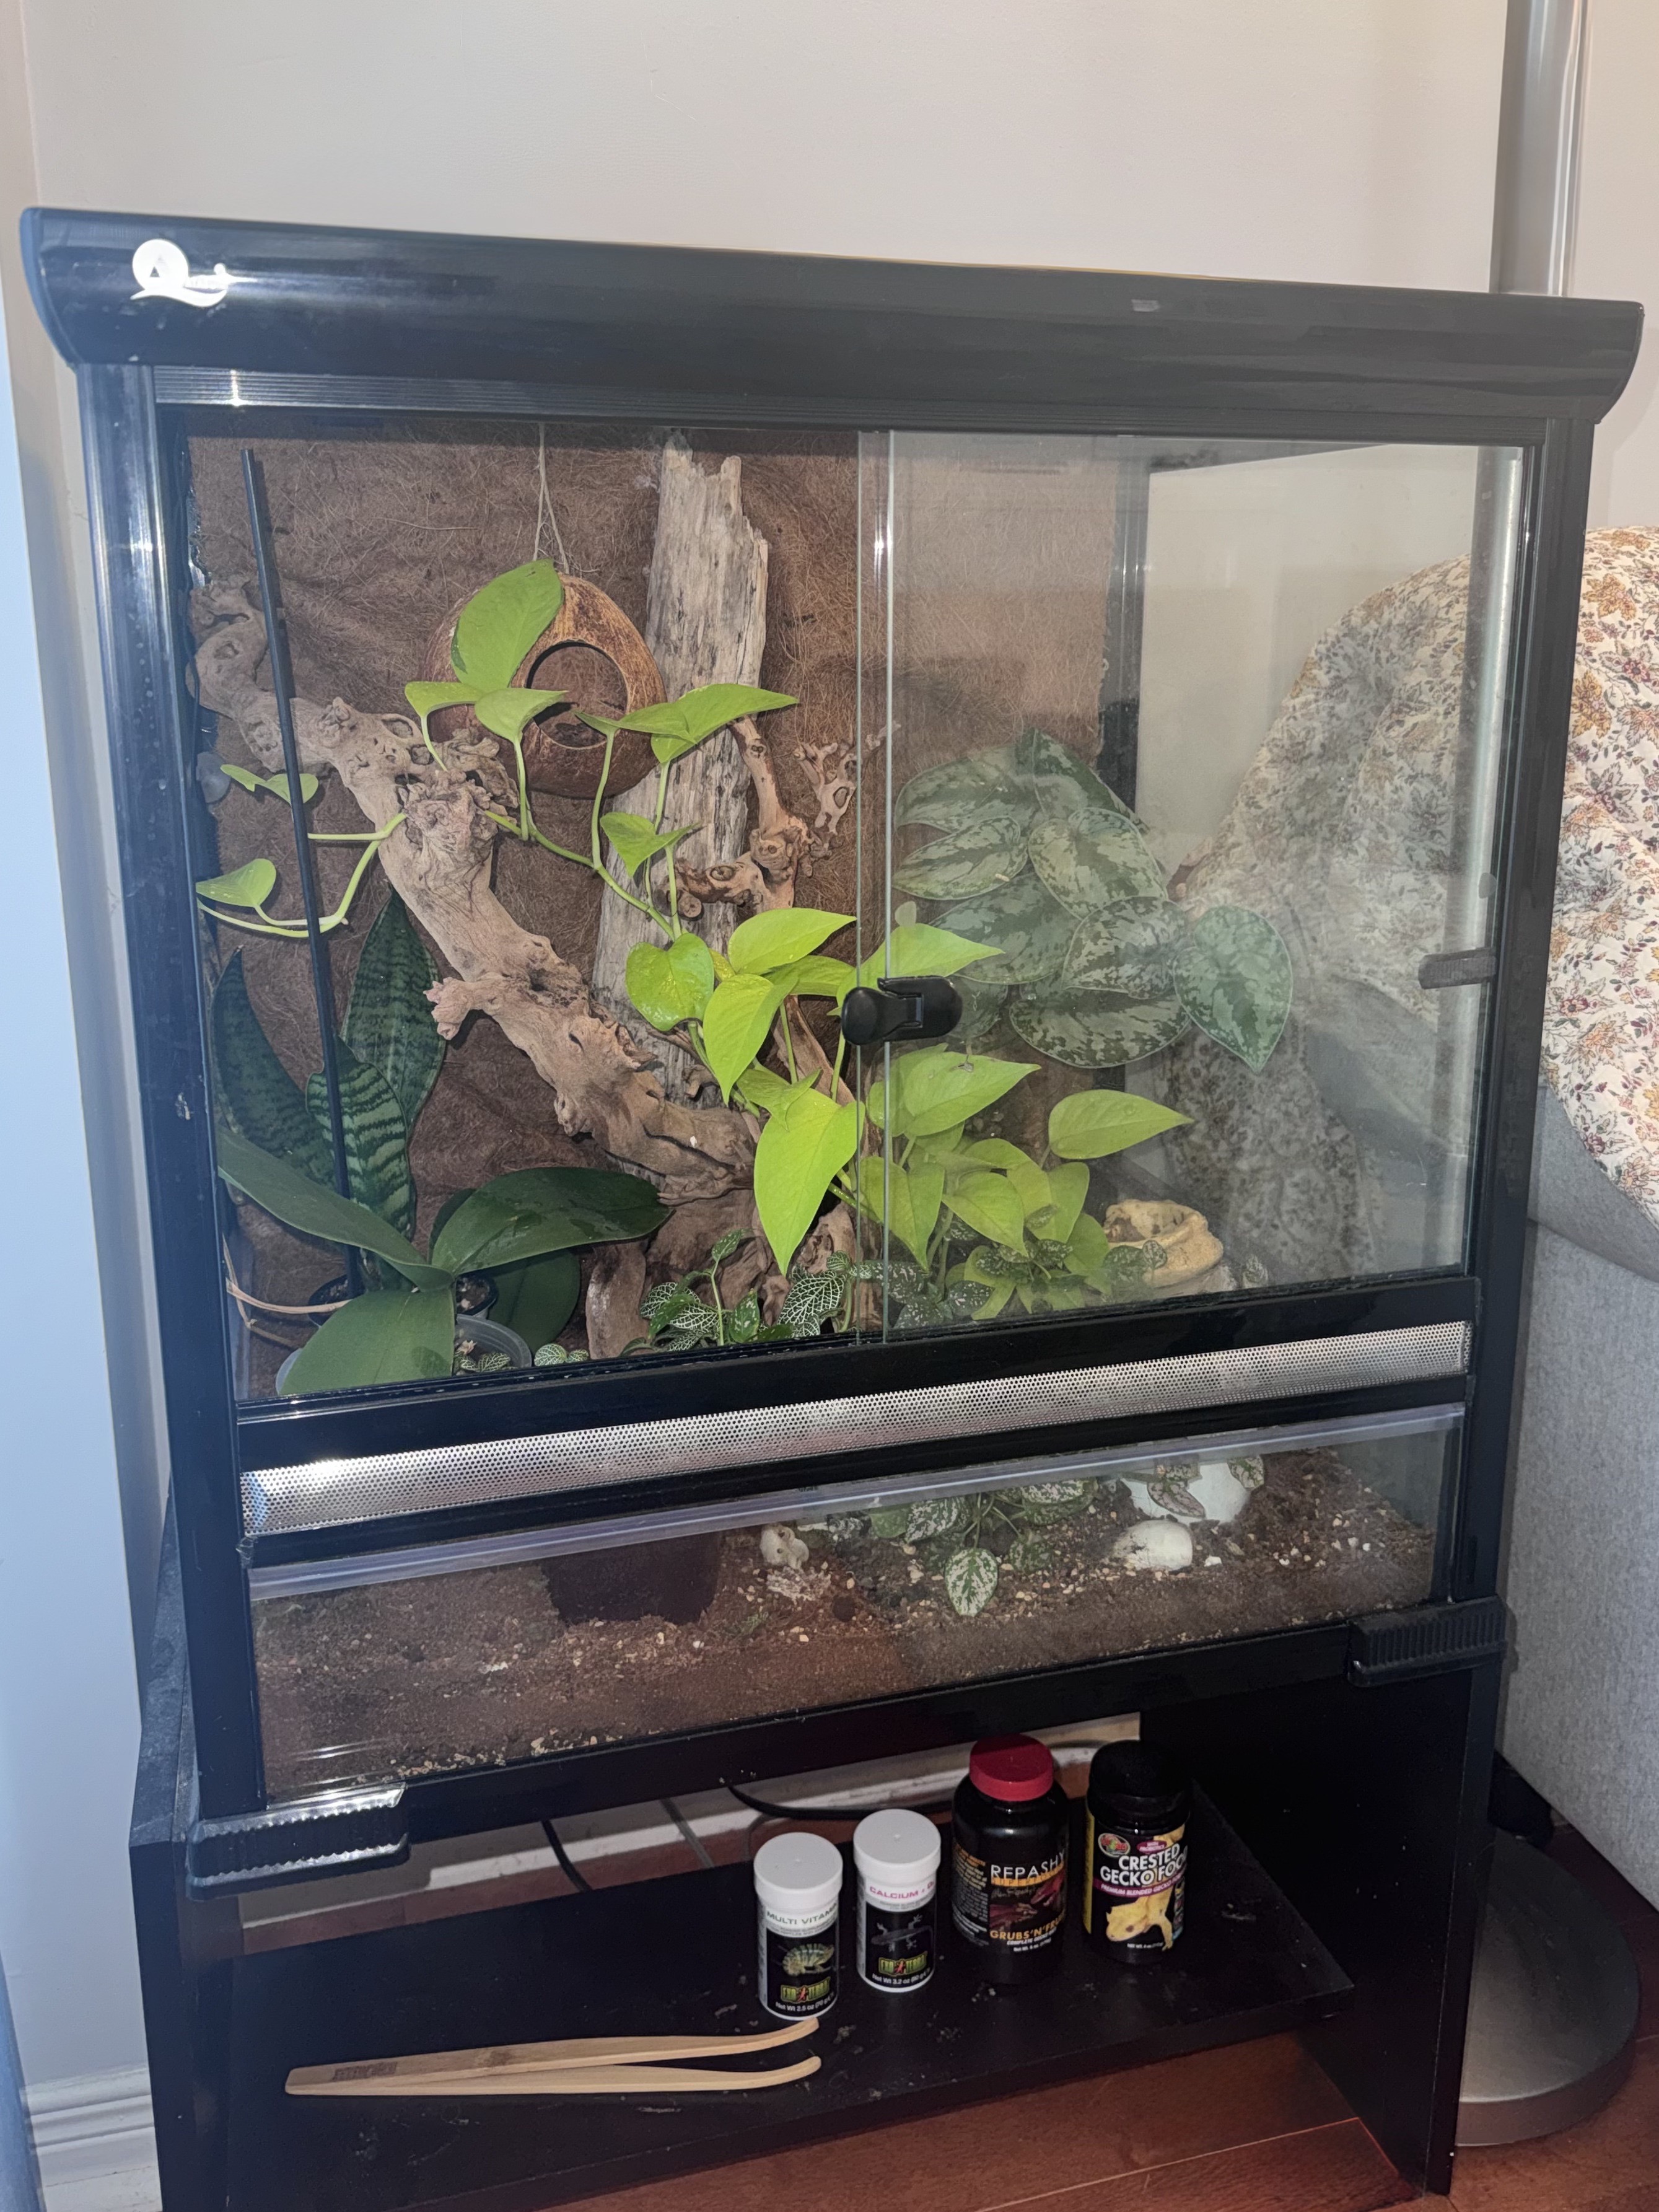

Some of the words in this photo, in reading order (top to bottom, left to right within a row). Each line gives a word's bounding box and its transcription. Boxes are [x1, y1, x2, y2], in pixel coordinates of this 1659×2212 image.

[991, 1848, 1065, 1880] REPASHY
[1118, 1843, 1181, 1871] CRESTED
[1100, 1865, 1155, 1886] GECKO
[869, 1885, 919, 1899] CALCIUM
[767, 1910, 797, 1925] MULTI
